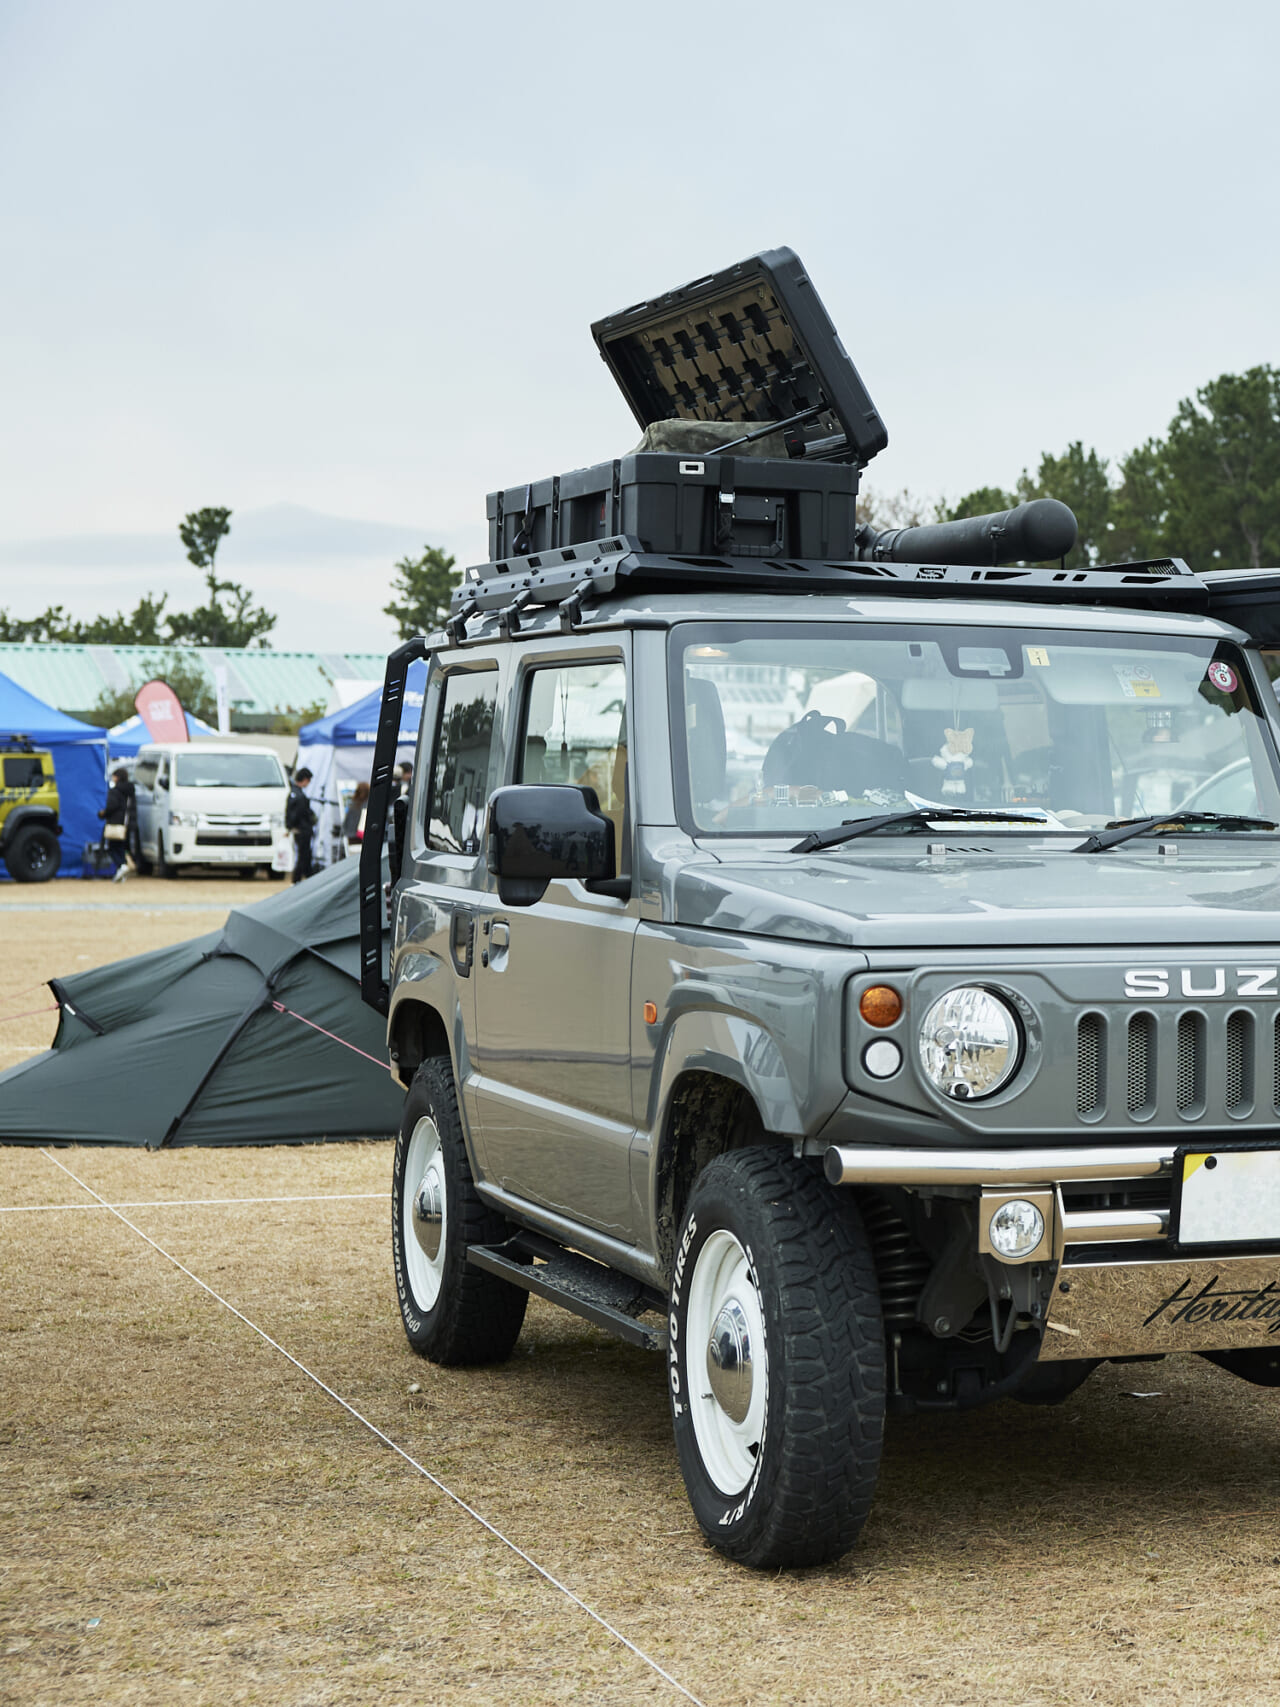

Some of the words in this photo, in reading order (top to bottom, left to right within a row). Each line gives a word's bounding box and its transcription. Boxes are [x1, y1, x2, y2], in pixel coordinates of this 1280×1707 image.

[393, 1185, 406, 1301] COUNTRY
[671, 1212, 698, 1306] TIRES
[403, 1303, 421, 1334] OPEN
[670, 1312, 683, 1418] TOYO
